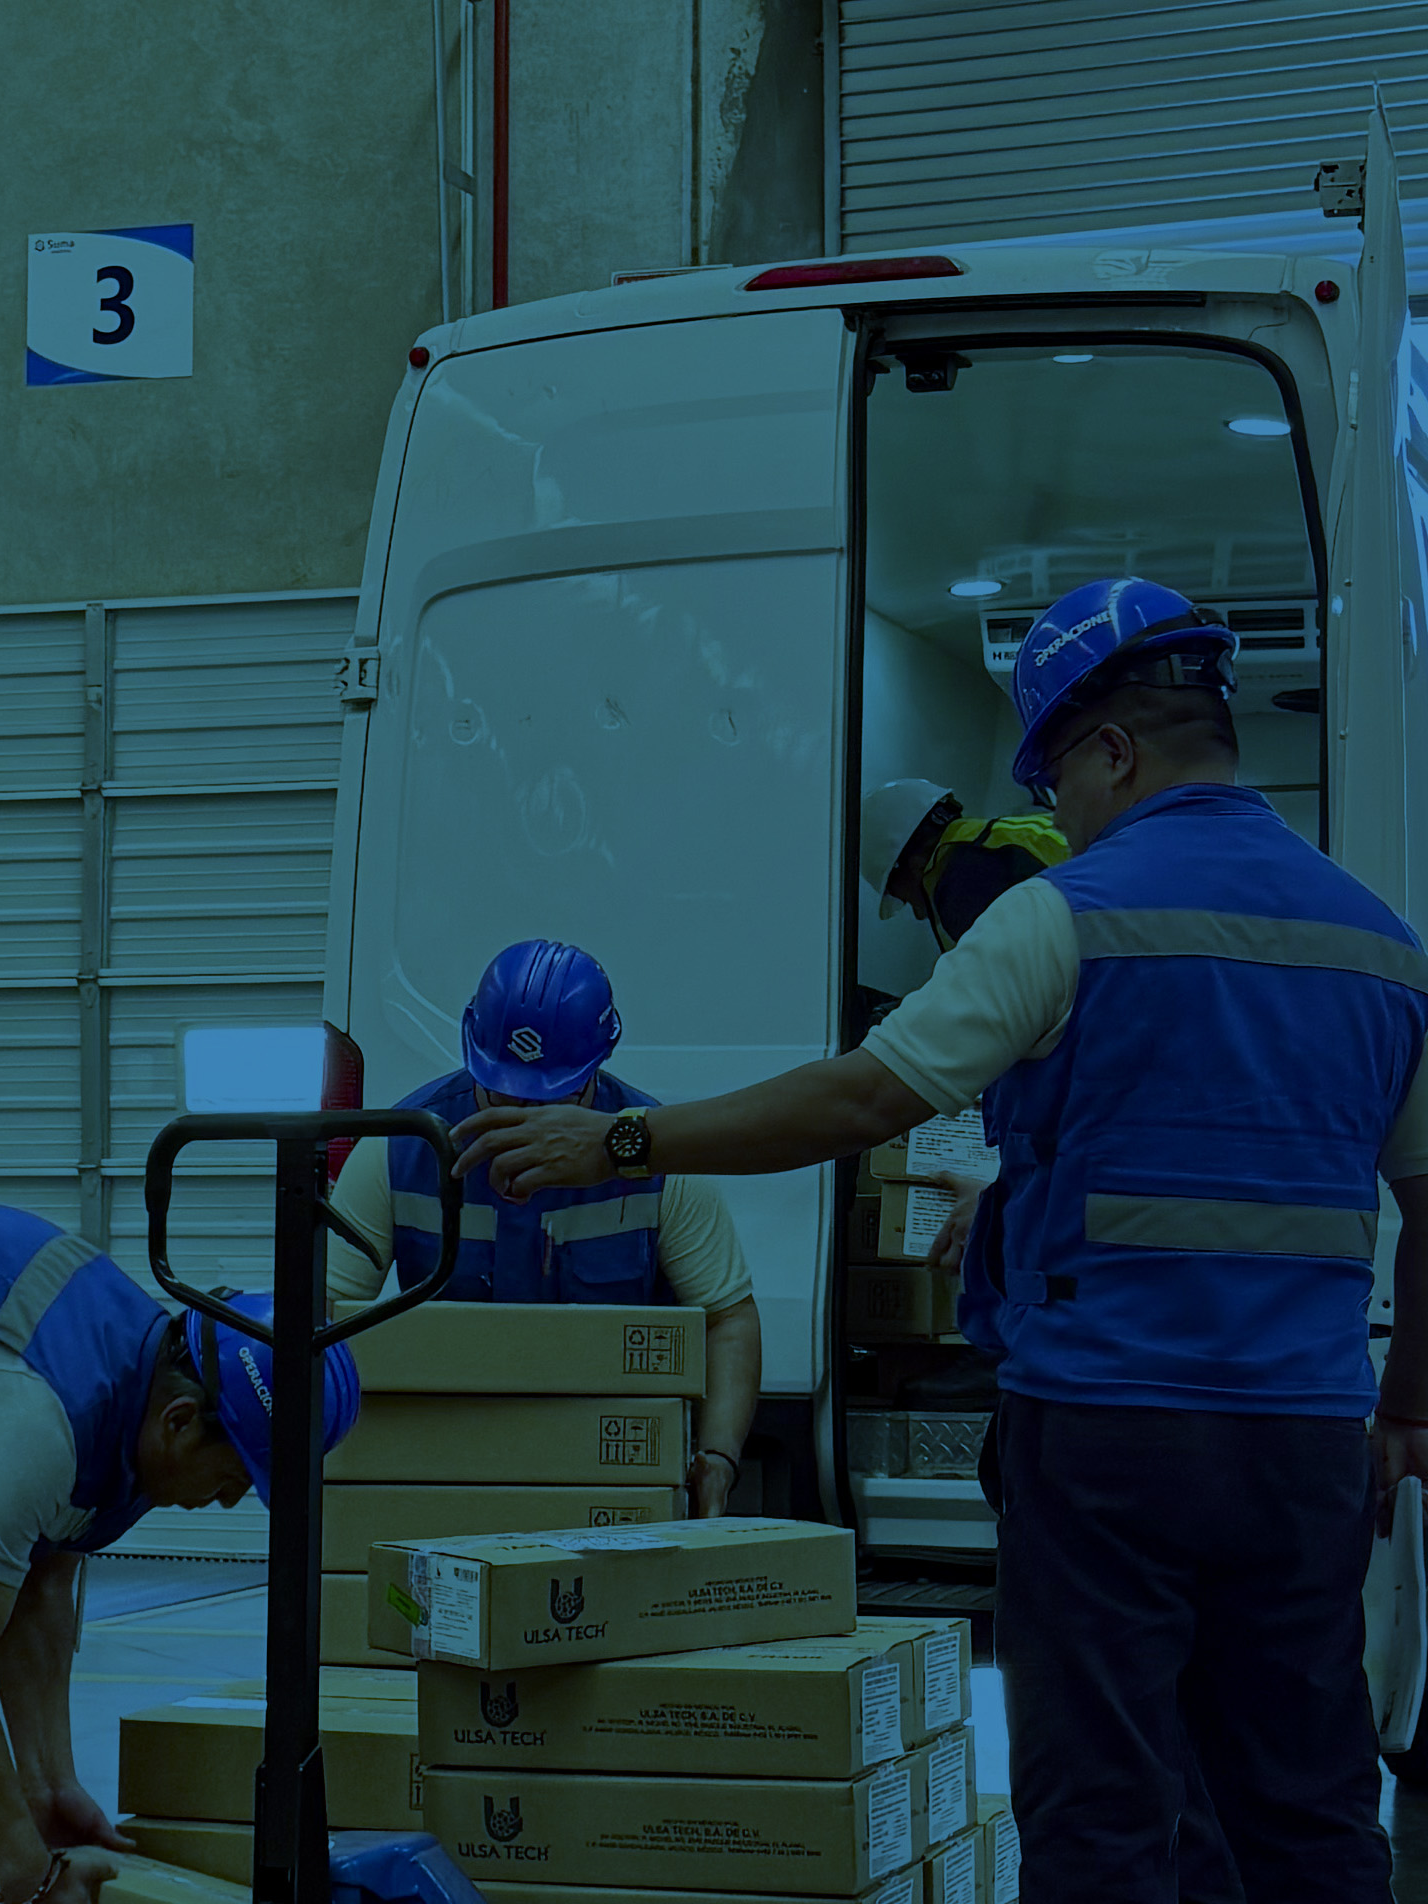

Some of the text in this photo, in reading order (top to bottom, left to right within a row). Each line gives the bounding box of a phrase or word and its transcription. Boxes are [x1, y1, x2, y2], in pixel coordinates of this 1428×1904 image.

[92, 265, 135, 345] 3
[524, 1623, 607, 1644] ULSA TECH
[454, 1729, 546, 1746] ULSA TECH
[458, 1843, 549, 1861] ULSA TECH
